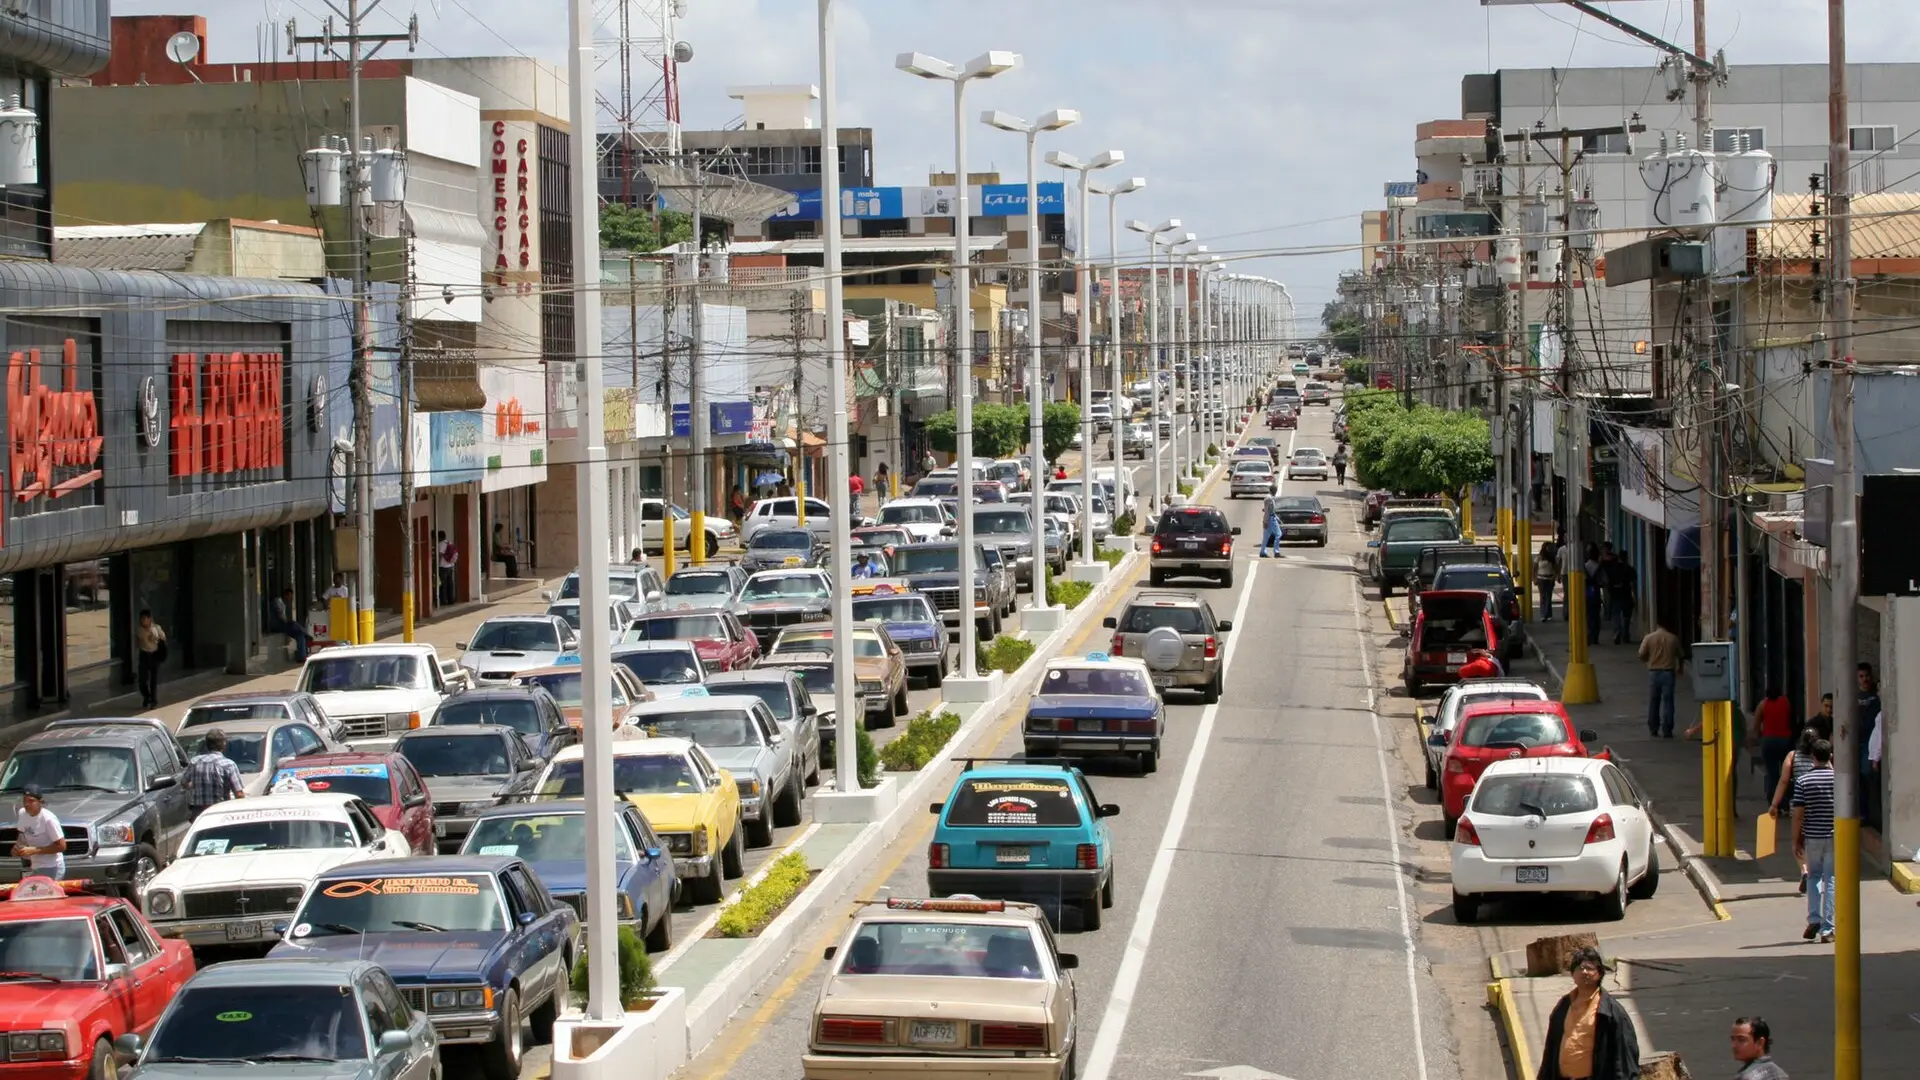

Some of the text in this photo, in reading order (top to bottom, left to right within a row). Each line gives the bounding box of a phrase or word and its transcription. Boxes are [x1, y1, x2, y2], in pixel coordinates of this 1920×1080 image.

[492, 121, 508, 287] COMERCIAL
[517, 138, 530, 267] CARACAS
[411, 886, 480, 895] Abundante
